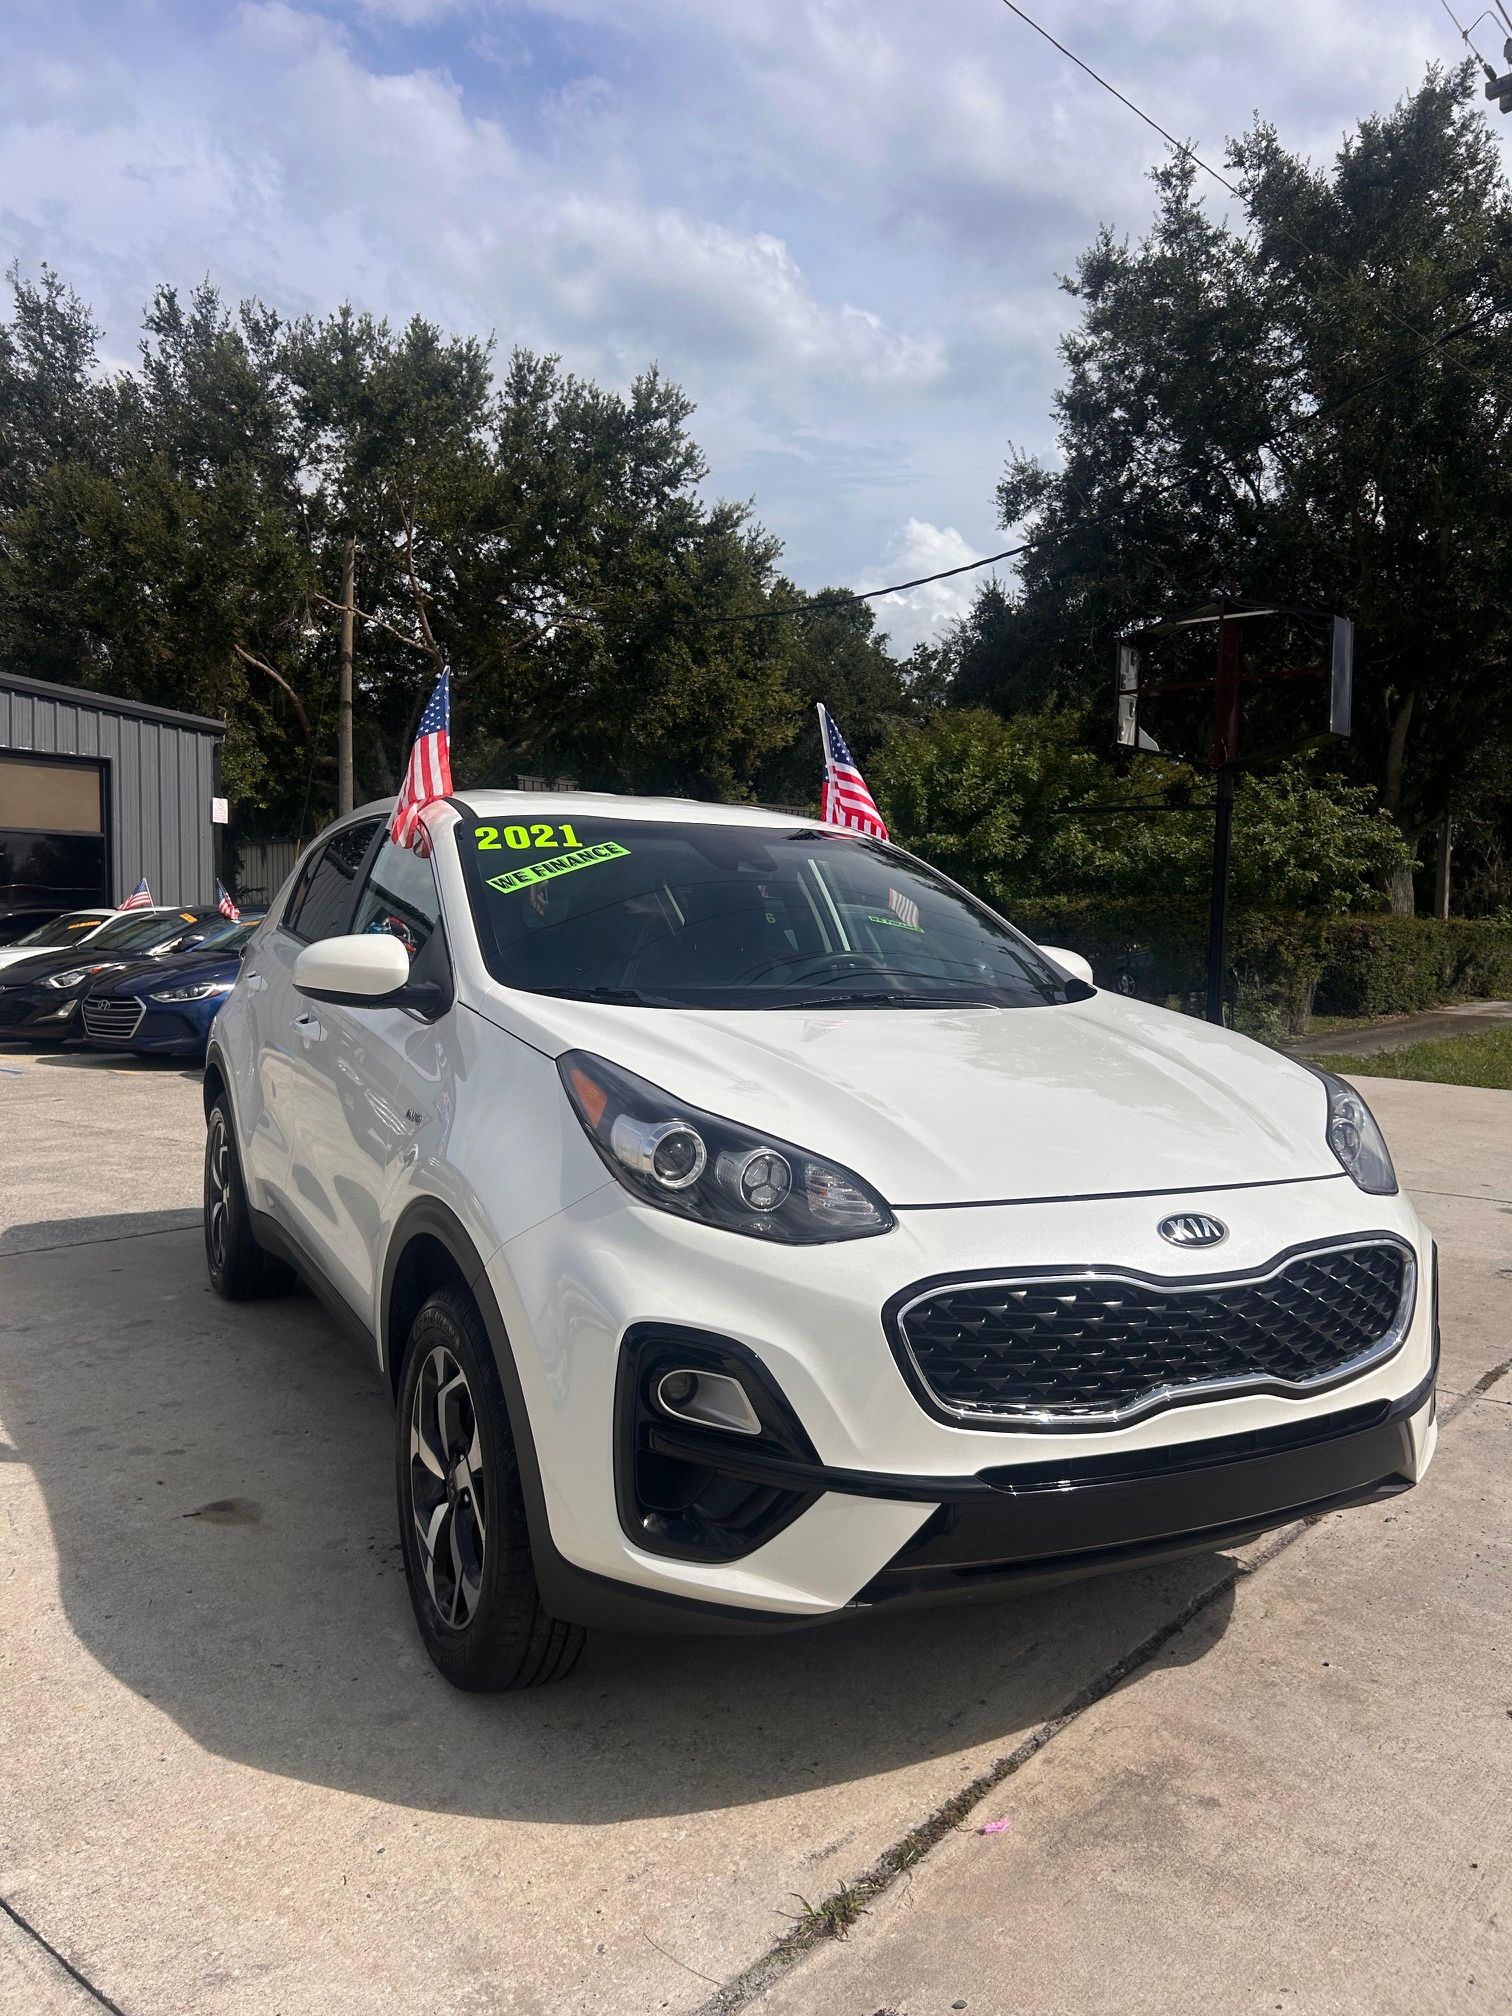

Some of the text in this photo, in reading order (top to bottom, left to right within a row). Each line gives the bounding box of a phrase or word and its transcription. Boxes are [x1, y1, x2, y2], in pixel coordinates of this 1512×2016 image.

[474, 825, 583, 849] 2021
[493, 844, 622, 889] WE FINANCE
[1167, 1218, 1221, 1240] KIA
